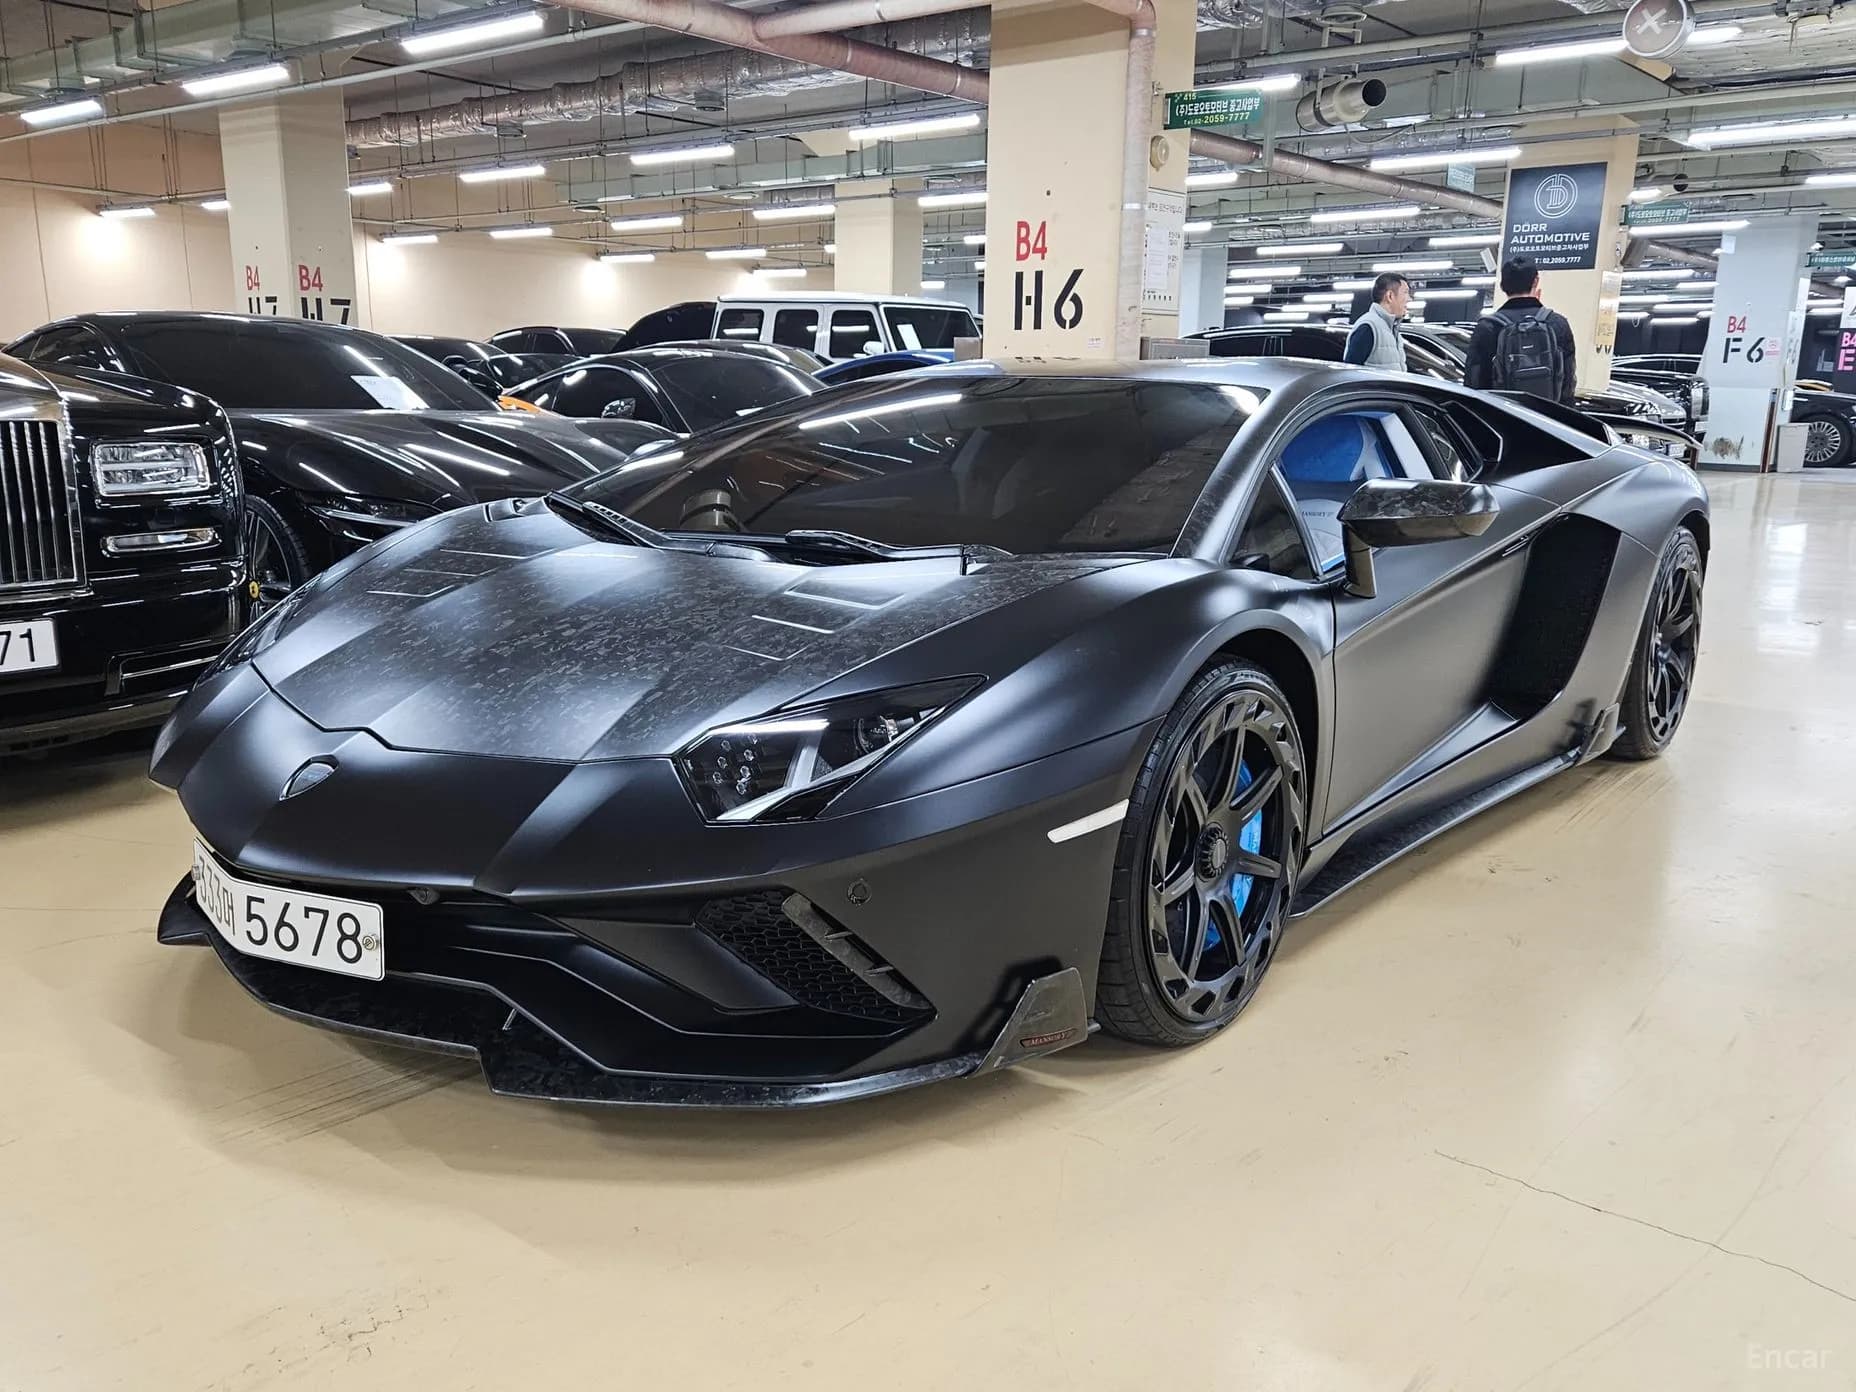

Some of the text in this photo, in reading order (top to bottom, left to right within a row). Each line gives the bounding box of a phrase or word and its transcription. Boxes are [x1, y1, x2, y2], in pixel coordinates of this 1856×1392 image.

[1015, 220, 1048, 262] B4
[1511, 233, 1590, 244] AUTOMOTIVE
[245, 264, 260, 291] B4
[298, 264, 324, 292] B4
[1014, 268, 1084, 331] H6
[1727, 316, 1746, 333] B4
[246, 895, 363, 964] 5678
